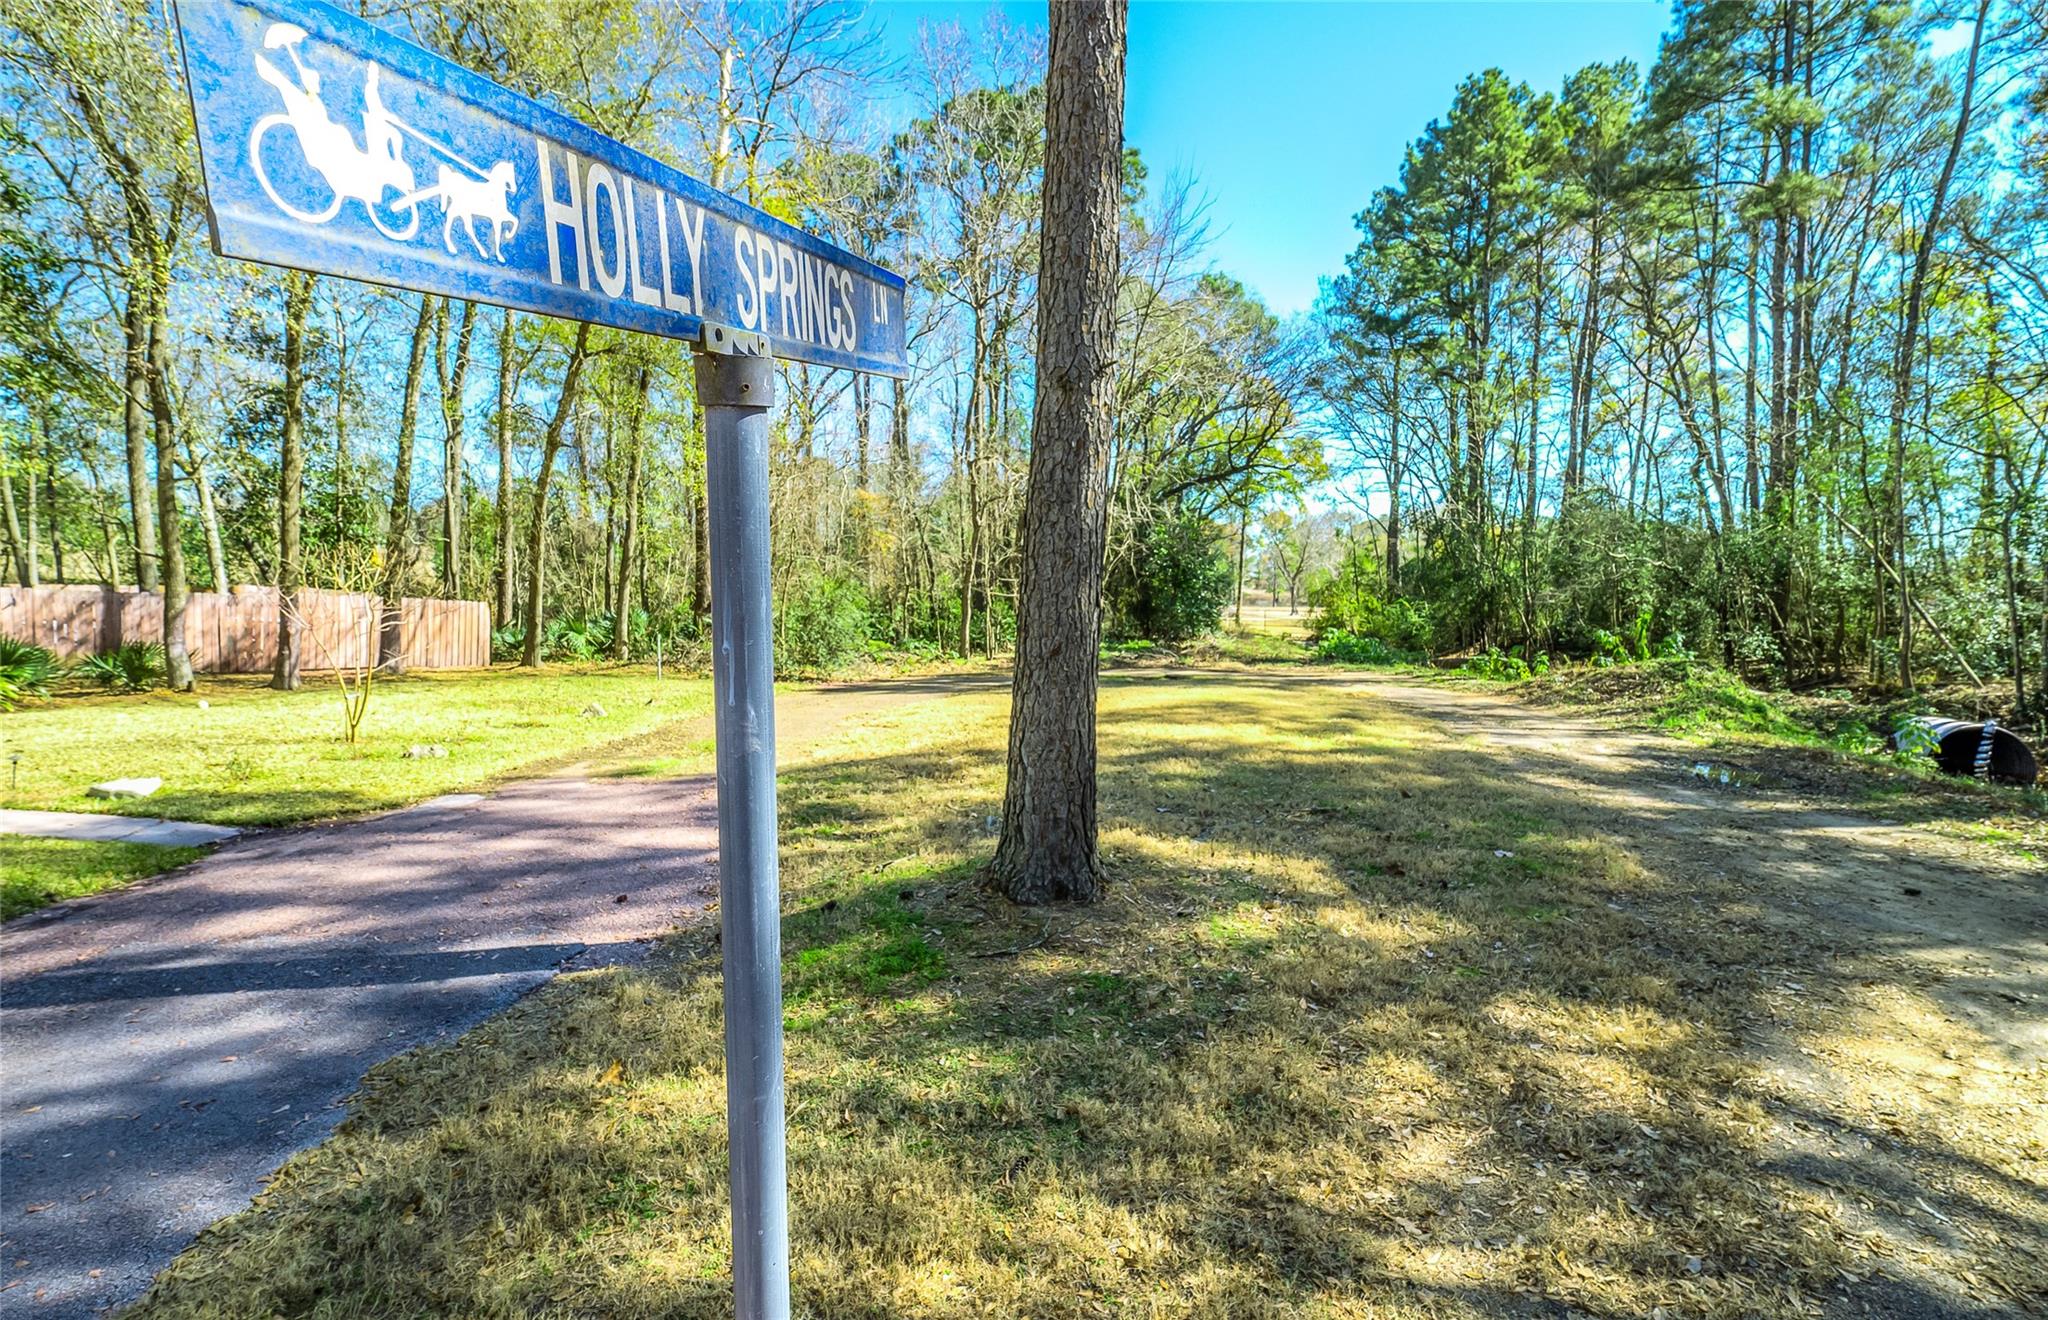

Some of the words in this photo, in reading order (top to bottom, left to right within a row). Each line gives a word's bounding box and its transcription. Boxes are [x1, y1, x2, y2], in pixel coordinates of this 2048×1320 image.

[537, 139, 704, 316] HOLLY
[734, 225, 856, 352] SPRINGS
[872, 282, 889, 325] LN
